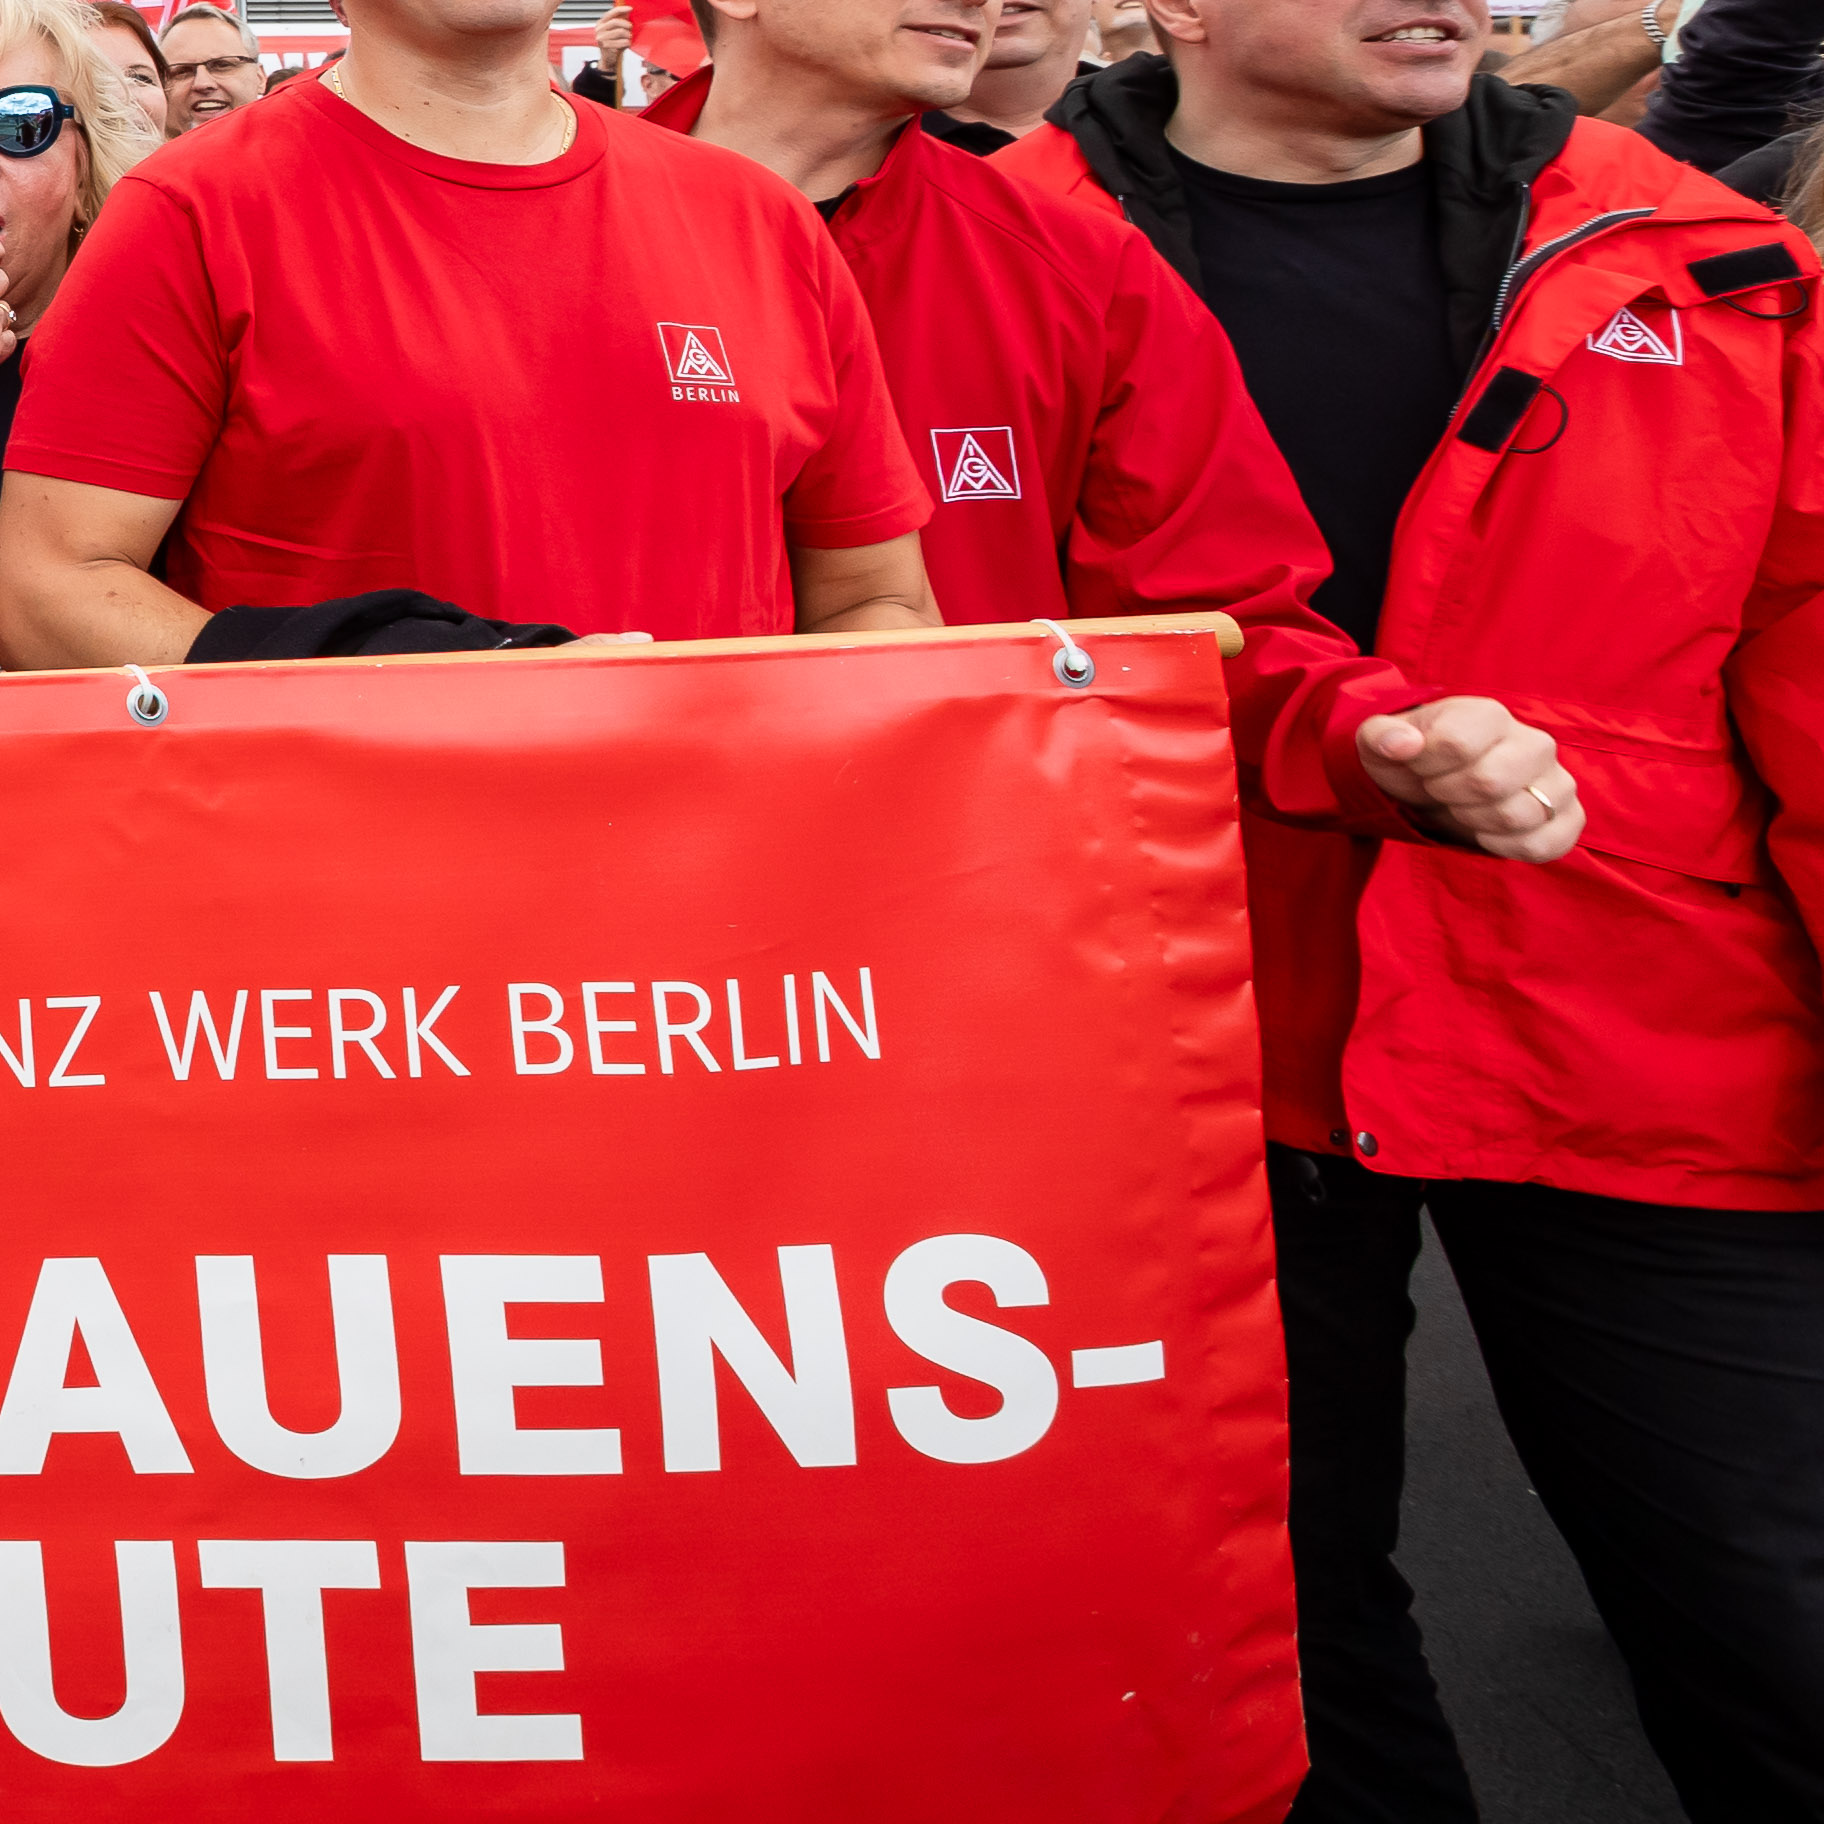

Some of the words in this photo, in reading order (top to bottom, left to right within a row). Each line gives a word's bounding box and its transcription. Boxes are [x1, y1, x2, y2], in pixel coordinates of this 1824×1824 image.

[671, 386, 741, 403] BERLIN
[147, 984, 472, 1082] WERK
[507, 966, 884, 1077] BERLIN
